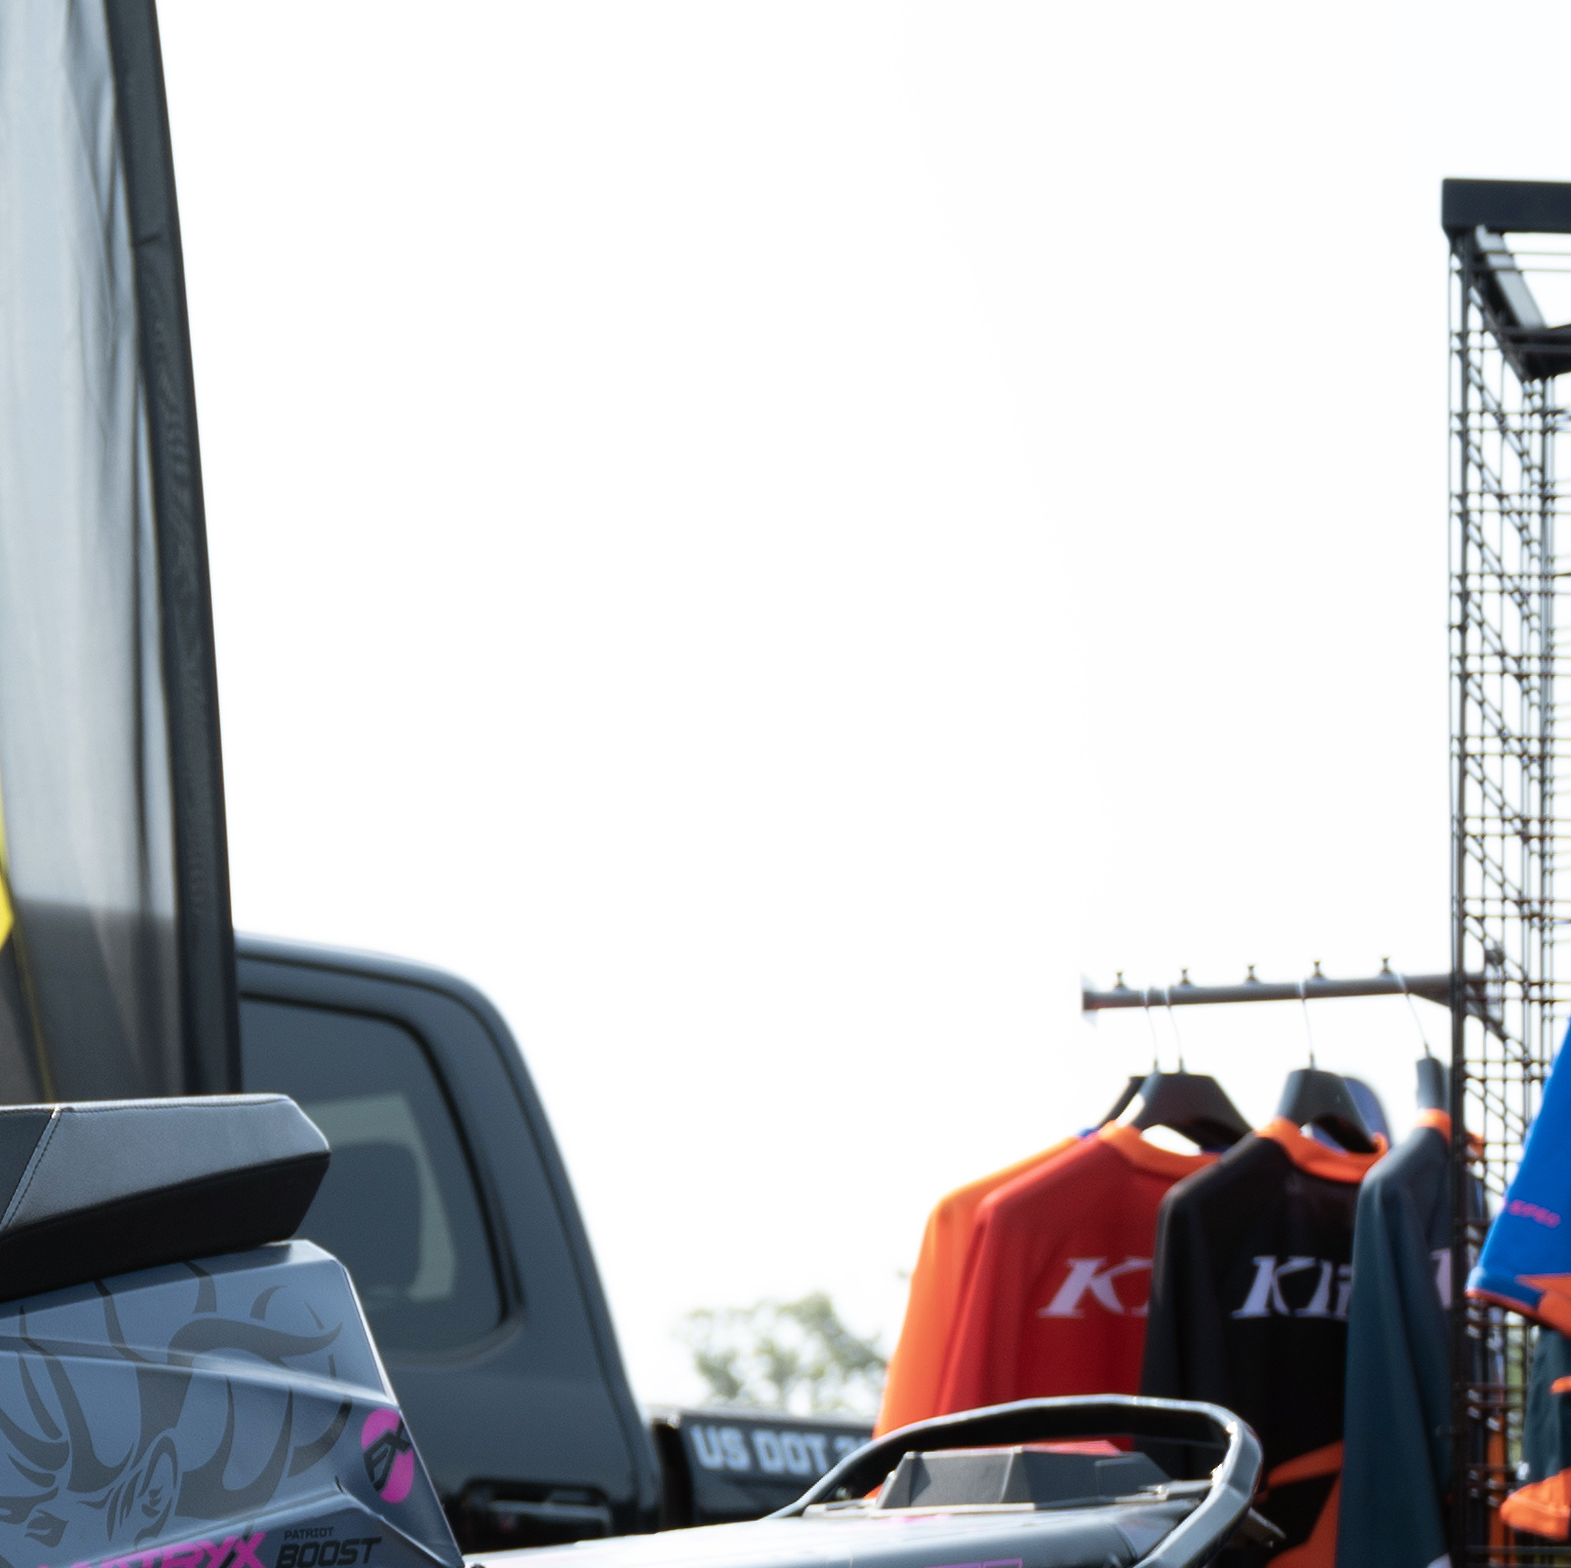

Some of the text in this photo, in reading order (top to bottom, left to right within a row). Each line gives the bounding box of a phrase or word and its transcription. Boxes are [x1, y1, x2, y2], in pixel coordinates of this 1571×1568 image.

[1230, 1254, 1351, 1320] Kli
[689, 1424, 752, 1472] US
[751, 1429, 832, 1477] DOT
[284, 1526, 335, 1541] PATRIOT
